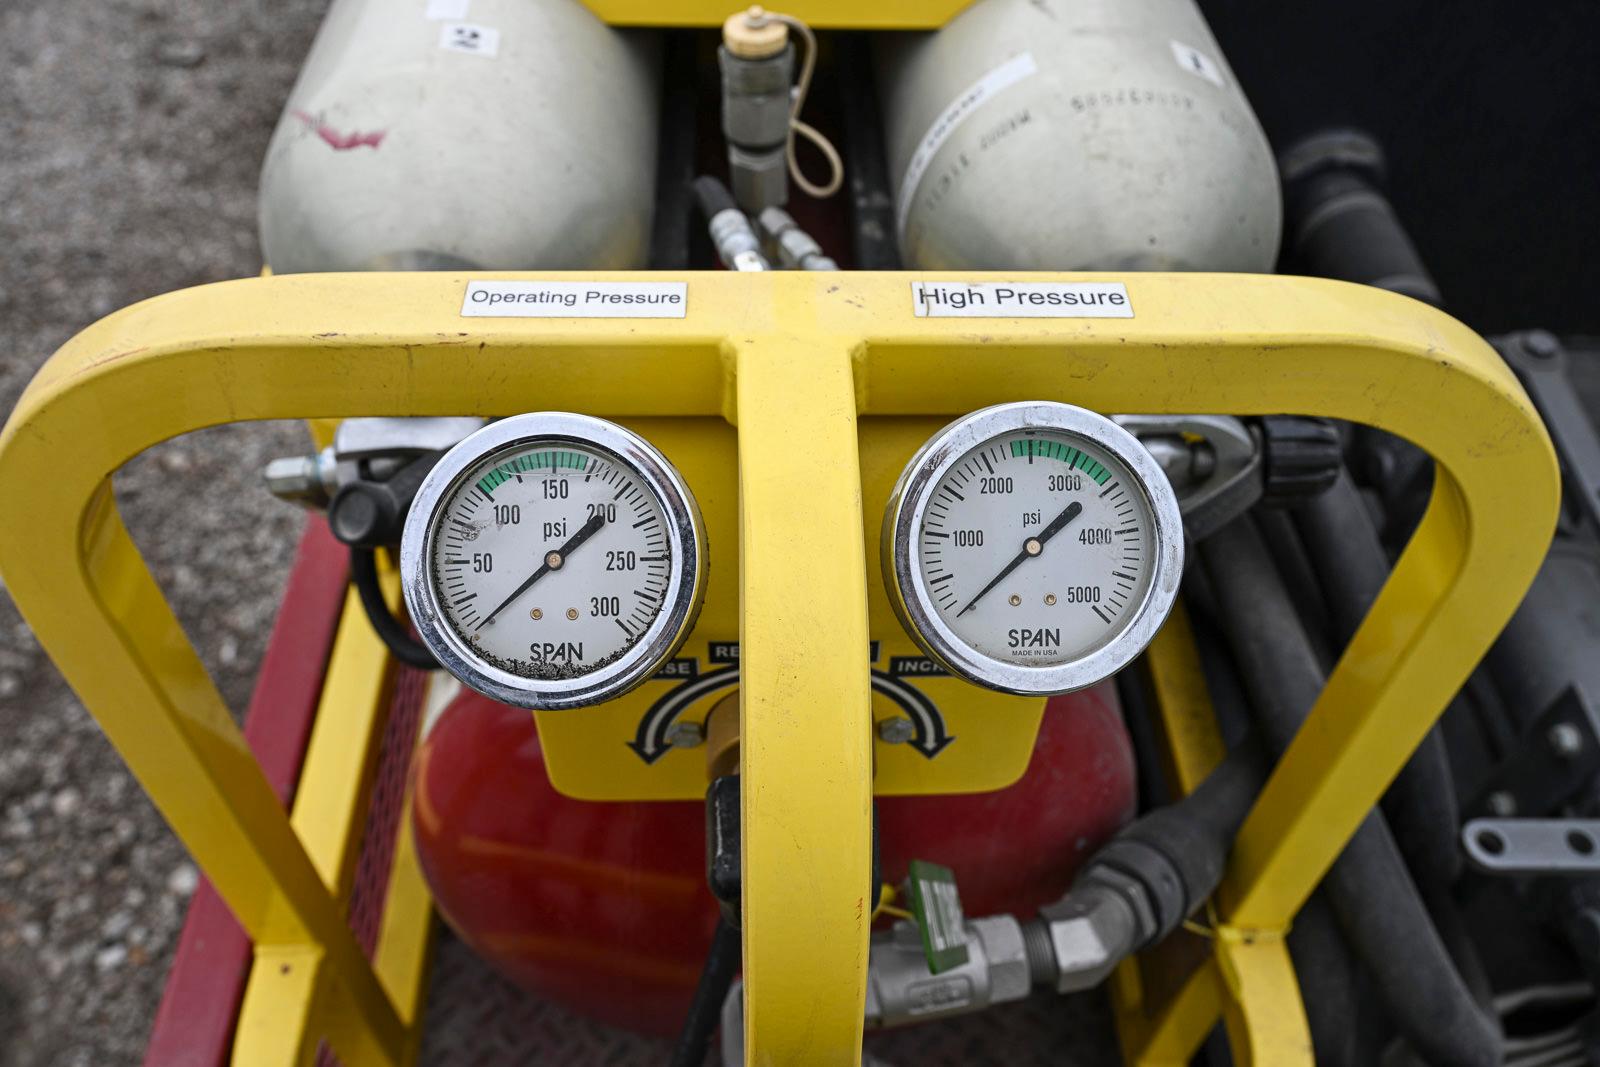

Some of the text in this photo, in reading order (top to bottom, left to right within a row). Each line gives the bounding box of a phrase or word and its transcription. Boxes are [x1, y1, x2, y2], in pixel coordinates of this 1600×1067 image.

[471, 290, 681, 306] Operating Pressure
[919, 288, 1125, 308] High Pressure
[541, 479, 569, 500] 150
[980, 477, 1014, 495] 2000
[1048, 475, 1082, 492] 3000
[493, 504, 521, 525] 100
[586, 503, 617, 525] 200
[1022, 509, 1042, 528] psi
[543, 517, 568, 542] psi
[952, 529, 984, 547] 1000
[1078, 528, 1113, 546] 4000
[472, 552, 494, 574] 50
[605, 550, 637, 572] 250
[1067, 586, 1102, 604] 5000
[590, 596, 621, 618] 300
[1007, 628, 1061, 648] SPAN
[529, 641, 584, 662] SPAN
